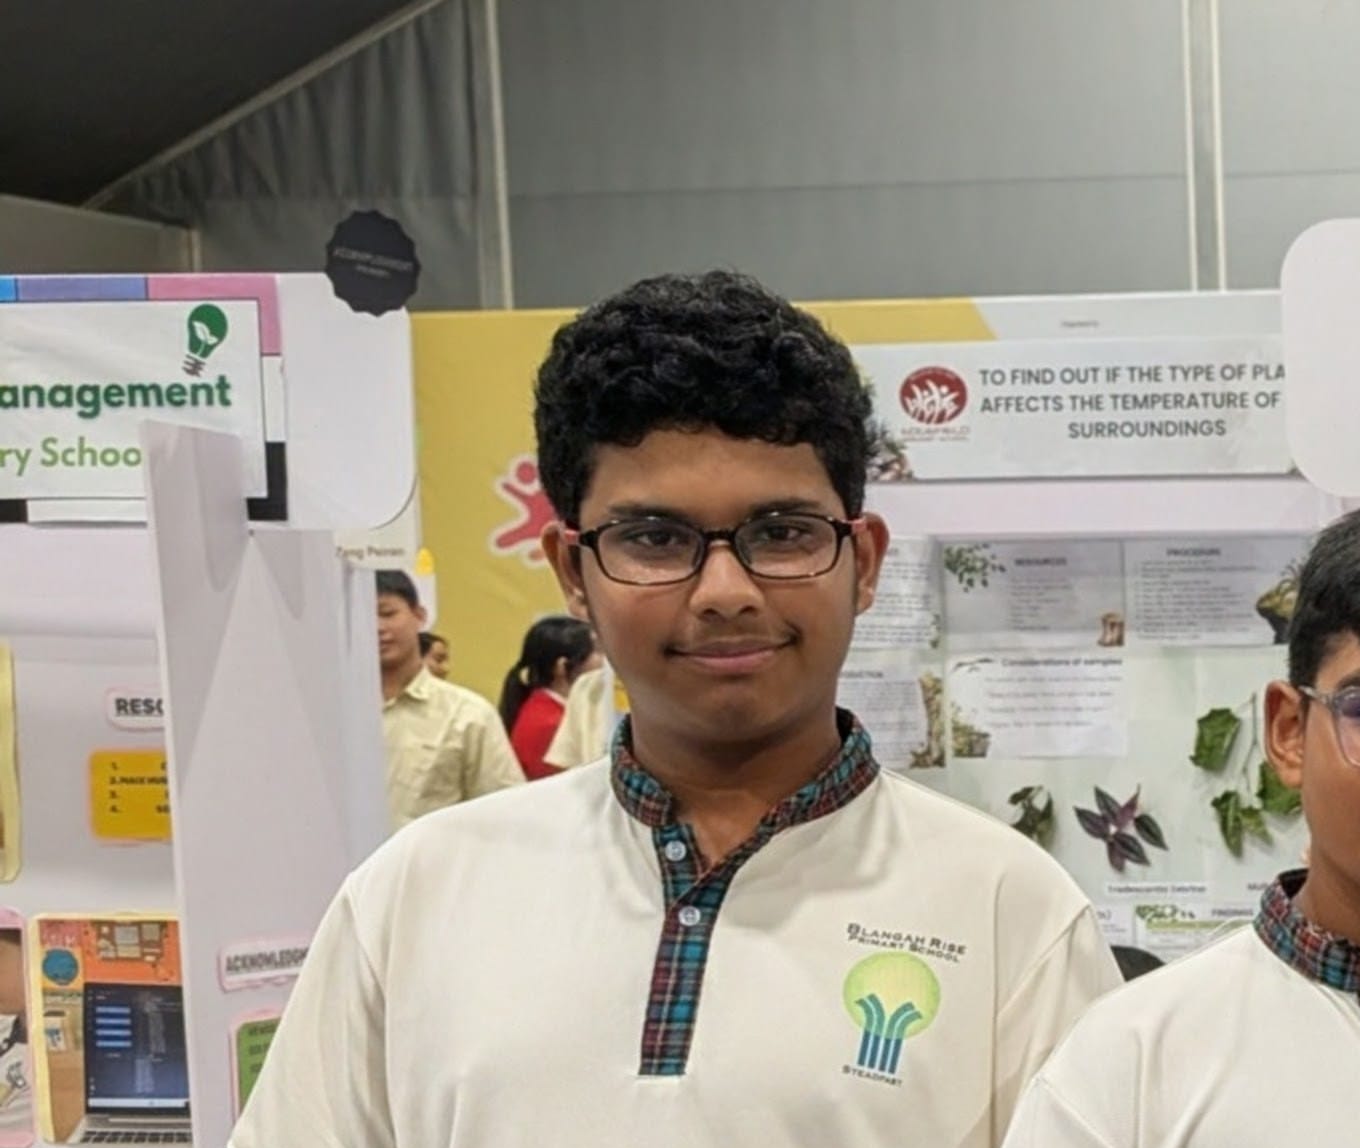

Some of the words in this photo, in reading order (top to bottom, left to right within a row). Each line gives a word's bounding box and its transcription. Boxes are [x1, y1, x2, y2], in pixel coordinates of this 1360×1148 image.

[979, 369, 1006, 387] TO
[1011, 367, 1055, 386] FIND
[1060, 366, 1100, 385] OUT
[1105, 366, 1121, 384] IF
[1127, 365, 1162, 384] THE
[1170, 365, 1214, 383] TYPE
[1219, 364, 1248, 382] OF
[979, 395, 1064, 414] AFFECTS
[1069, 394, 1104, 413] THE
[1110, 392, 1249, 412] TEMPERATURE
[1253, 391, 1281, 410] OF
[1067, 419, 1227, 440] SURROUNDINGS
[847, 922, 926, 945] BLANGAH
[930, 937, 967, 955] RISE
